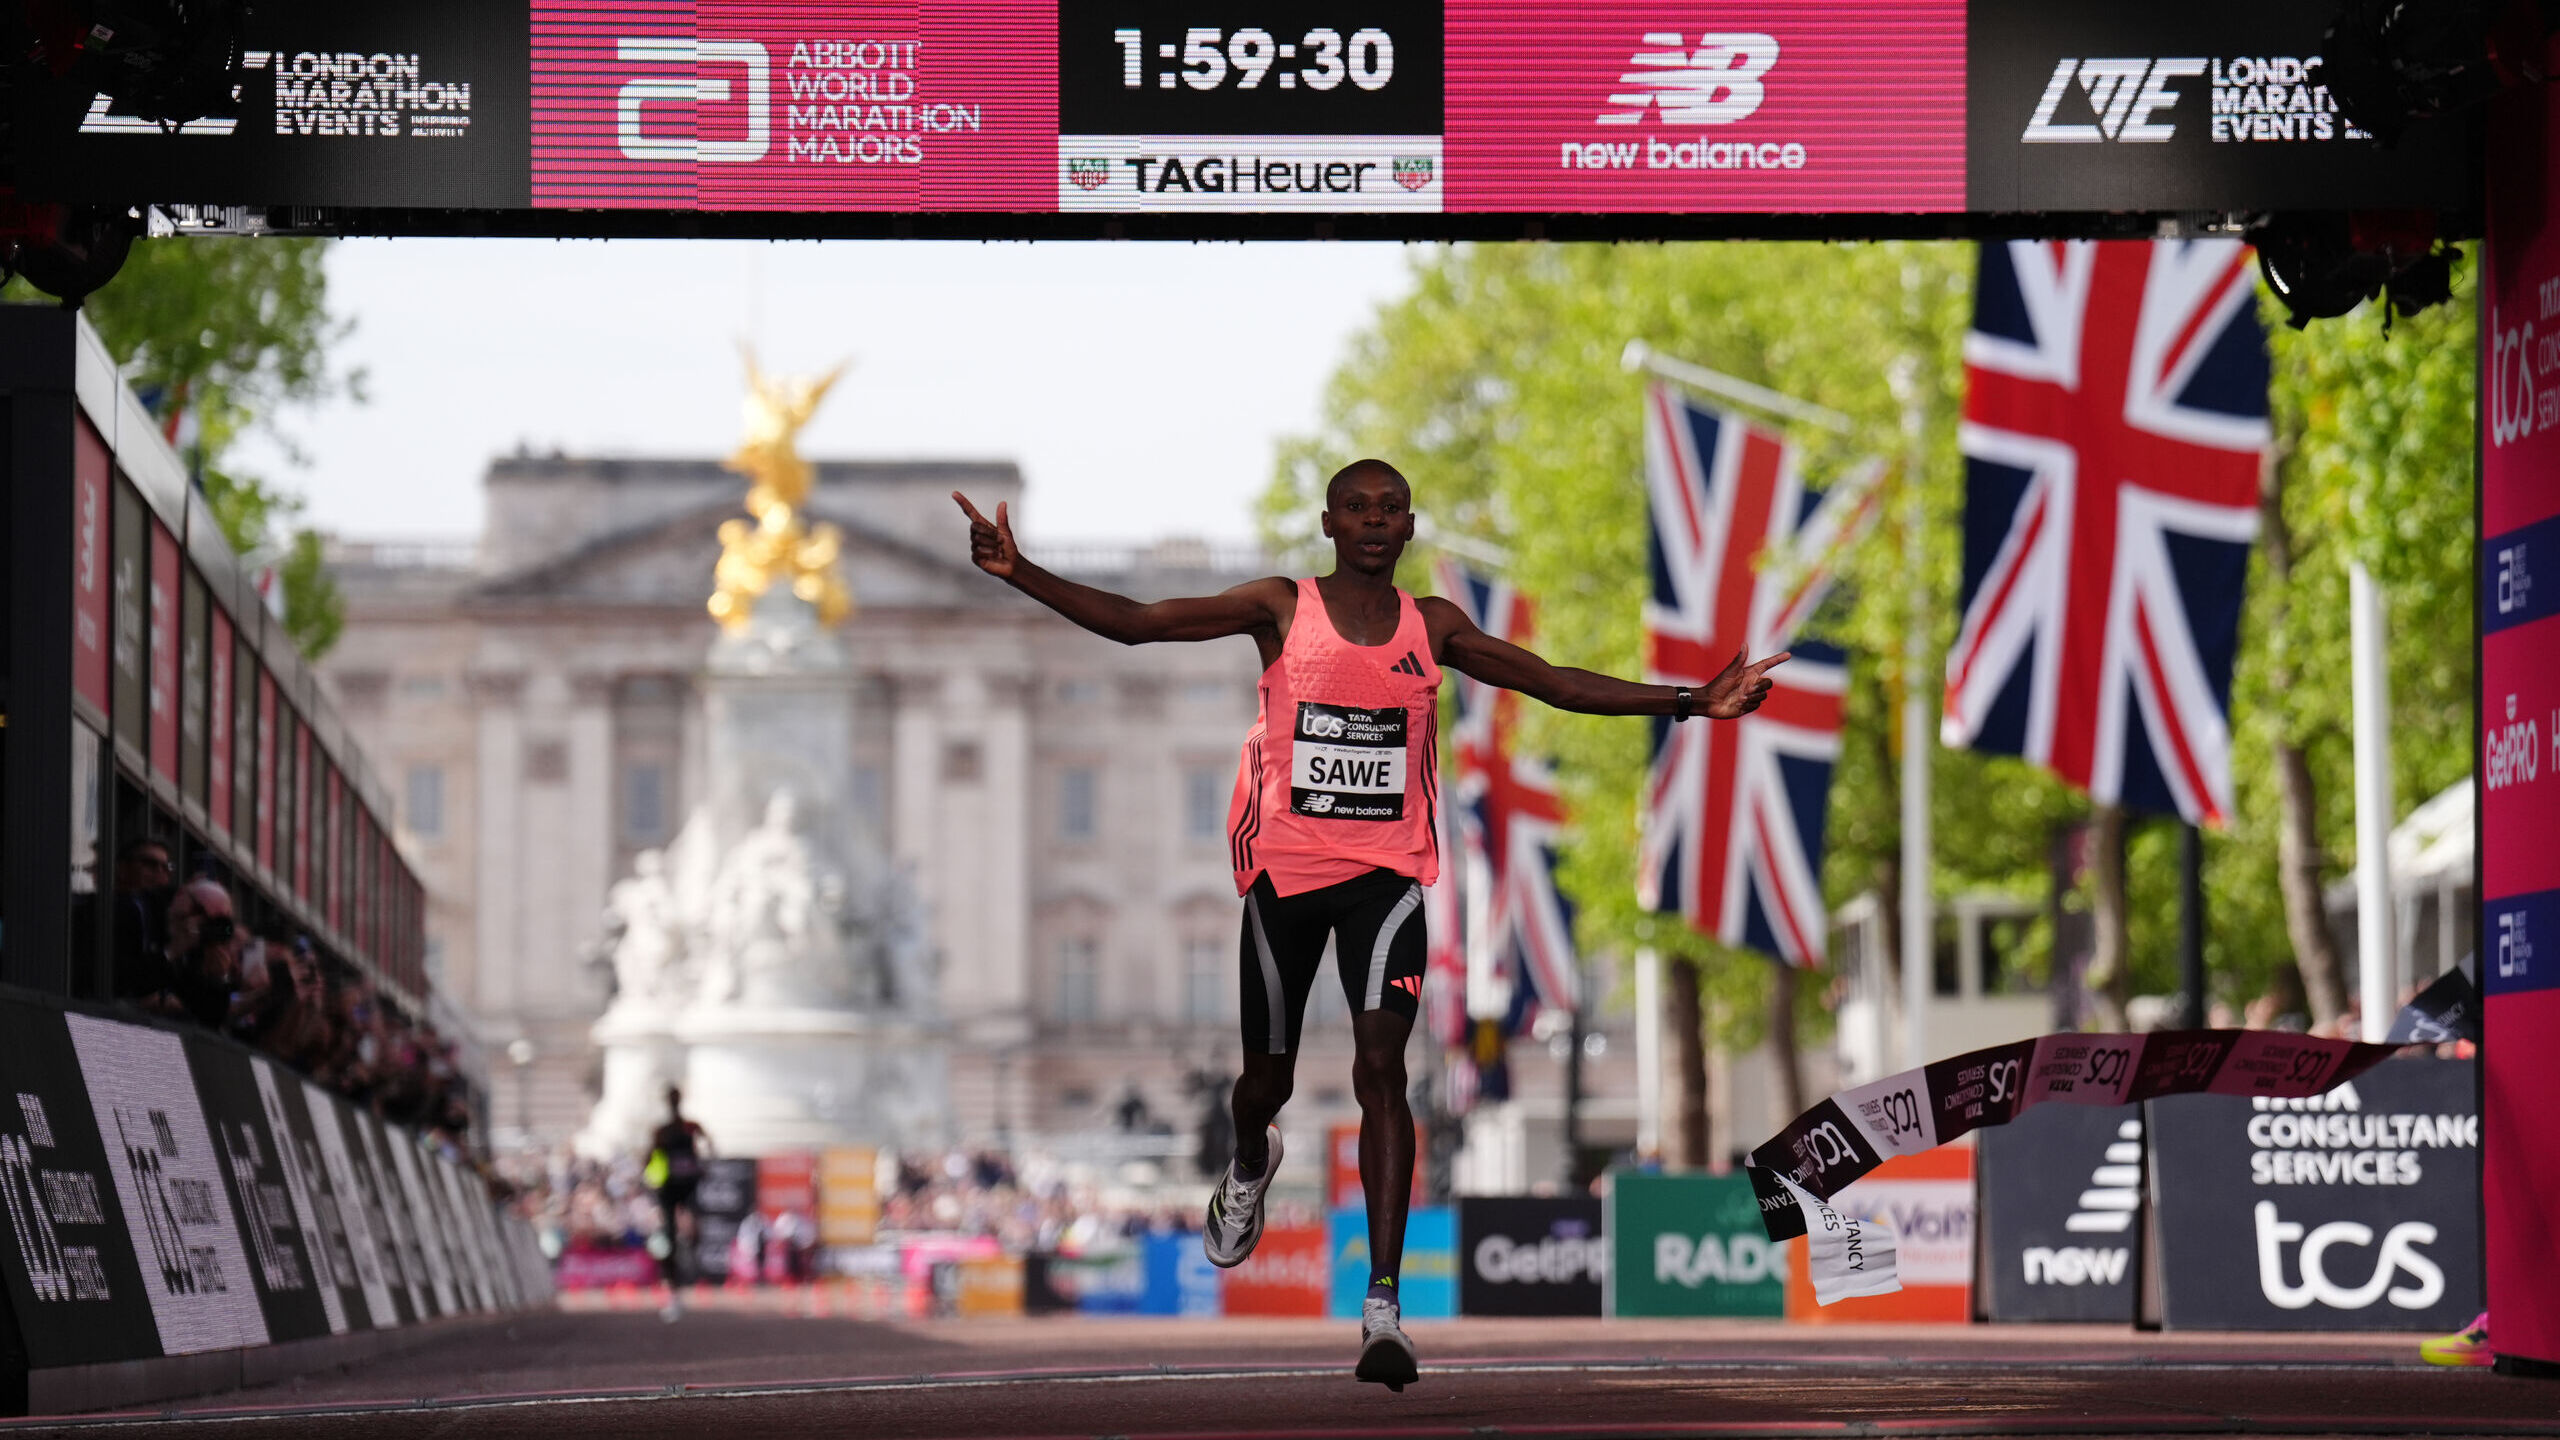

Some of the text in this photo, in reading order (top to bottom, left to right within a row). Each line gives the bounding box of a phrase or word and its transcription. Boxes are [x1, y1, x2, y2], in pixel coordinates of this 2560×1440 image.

[275, 51, 419, 80] LONDON
[788, 40, 923, 69] ABBOTT
[1114, 28, 1394, 90] 1:59:30
[275, 80, 471, 110] MARATHON
[788, 72, 915, 100] WORLD
[275, 110, 400, 136] EVENTS
[788, 104, 981, 132] MARATHON
[2211, 114, 2334, 143] EVENTS
[788, 134, 923, 163] MAJORS
[1561, 135, 1807, 169] new balance
[2492, 304, 2534, 448] tcs
[1302, 708, 1342, 738] tcs
[1347, 713, 1373, 722] TATA
[1347, 723, 1401, 732] CONSULTANCY
[1346, 732, 1384, 741] SERVICES
[1309, 756, 1391, 787] SAWE
[1334, 806, 1393, 816] new balance
[1989, 1058, 2022, 1103] cs
[2083, 1048, 2130, 1095] tcs
[2285, 1049, 2332, 1089] tcs
[1883, 1088, 1923, 1138] tcs
[1804, 1120, 1861, 1174] tcs
[2250, 1150, 2422, 1185] SERVICES
[113, 1106, 196, 1296] tcs
[2254, 1200, 2445, 1310] tcs
